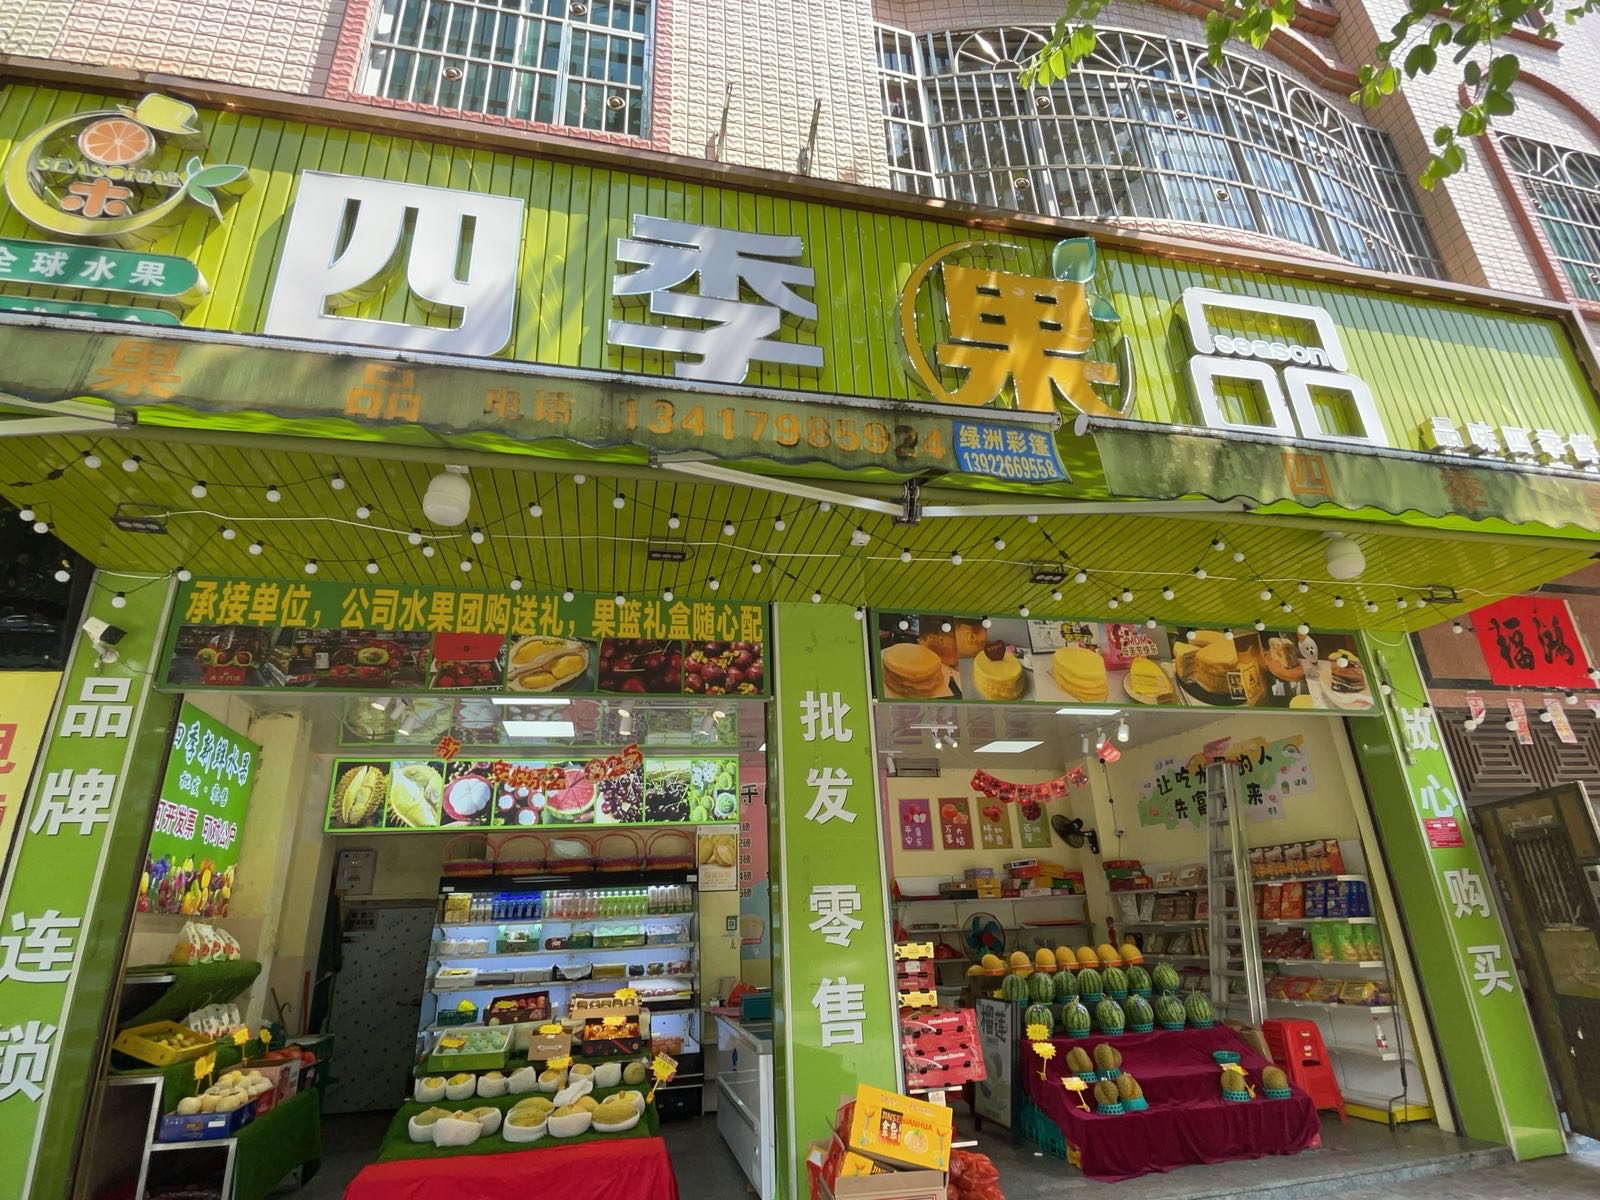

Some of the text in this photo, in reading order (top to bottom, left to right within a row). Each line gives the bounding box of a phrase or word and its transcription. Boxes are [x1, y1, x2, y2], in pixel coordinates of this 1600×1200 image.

[264, 168, 1387, 447] 四季果品
[1213, 333, 1332, 368] season
[484, 385, 575, 425] 电话
[963, 452, 1057, 478] 13922669558
[800, 690, 867, 1048] 批发零售
[1401, 707, 1514, 997] 放心购买
